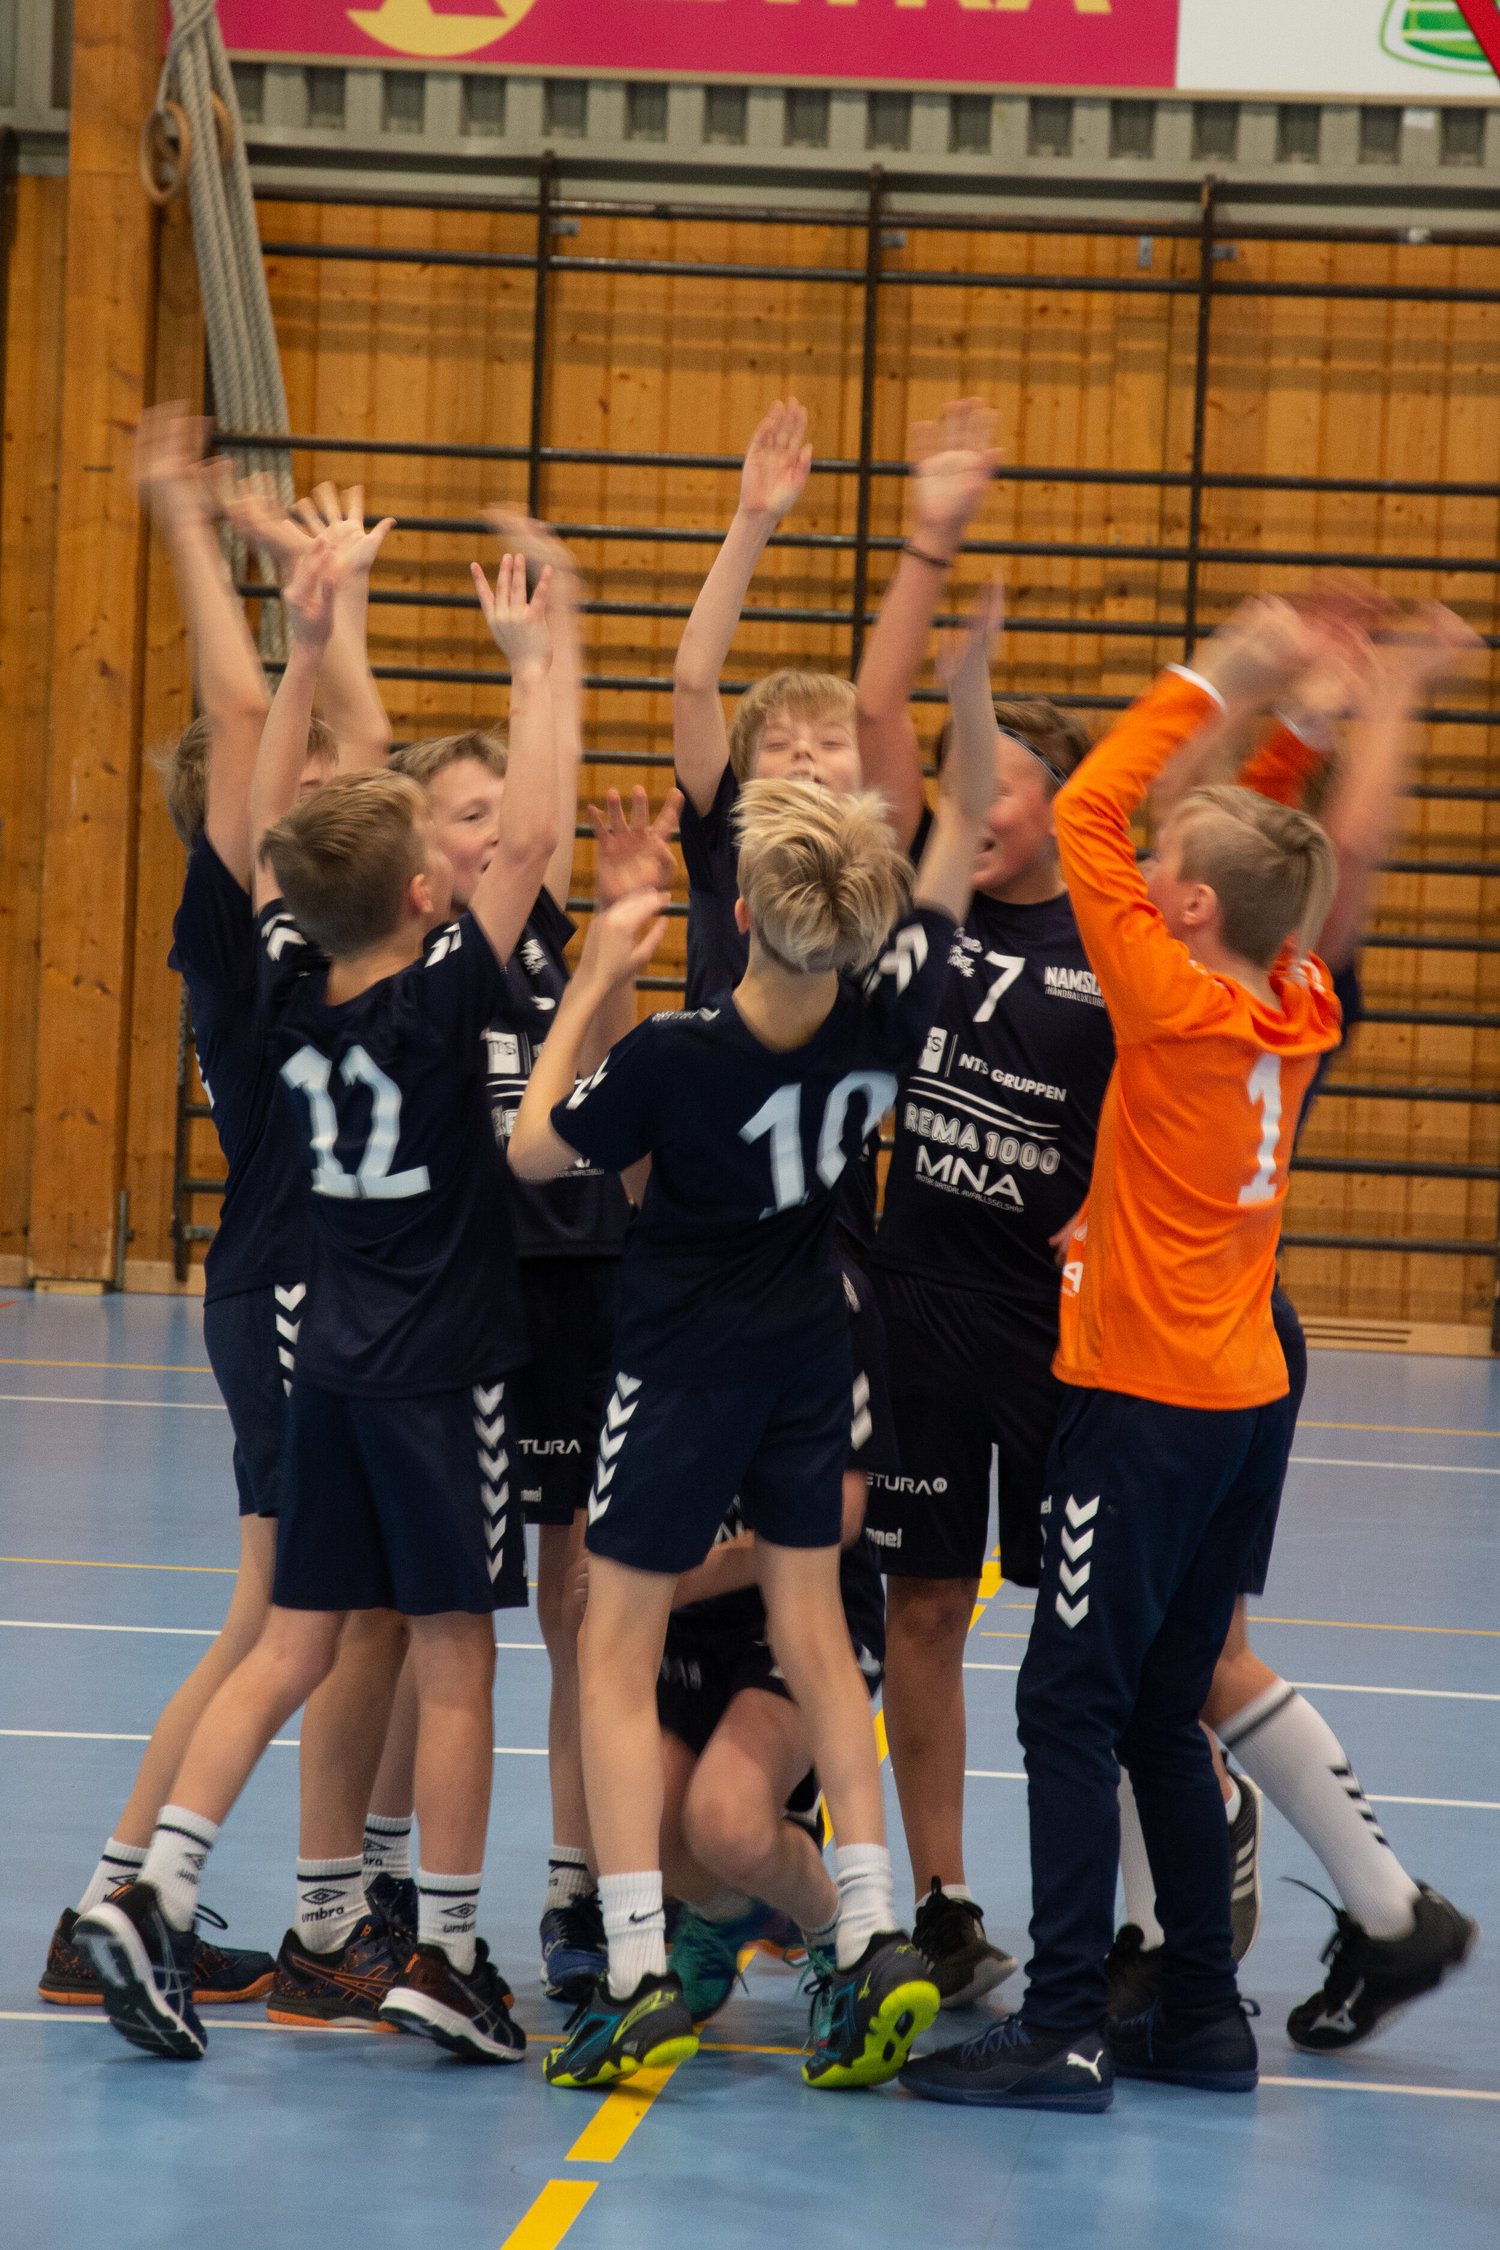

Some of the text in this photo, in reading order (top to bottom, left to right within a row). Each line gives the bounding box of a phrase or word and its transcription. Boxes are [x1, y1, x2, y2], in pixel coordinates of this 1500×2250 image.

[972, 950, 1026, 1023] 7
[958, 1053, 1067, 1102] NTS GRUPPEN
[279, 1044, 431, 1200] 12
[737, 1070, 898, 1221] 10
[904, 1102, 1061, 1175] REMA 1000
[1237, 1053, 1282, 1207] 1
[916, 1145, 1024, 1206] MNA
[518, 1439, 582, 1455] TURA
